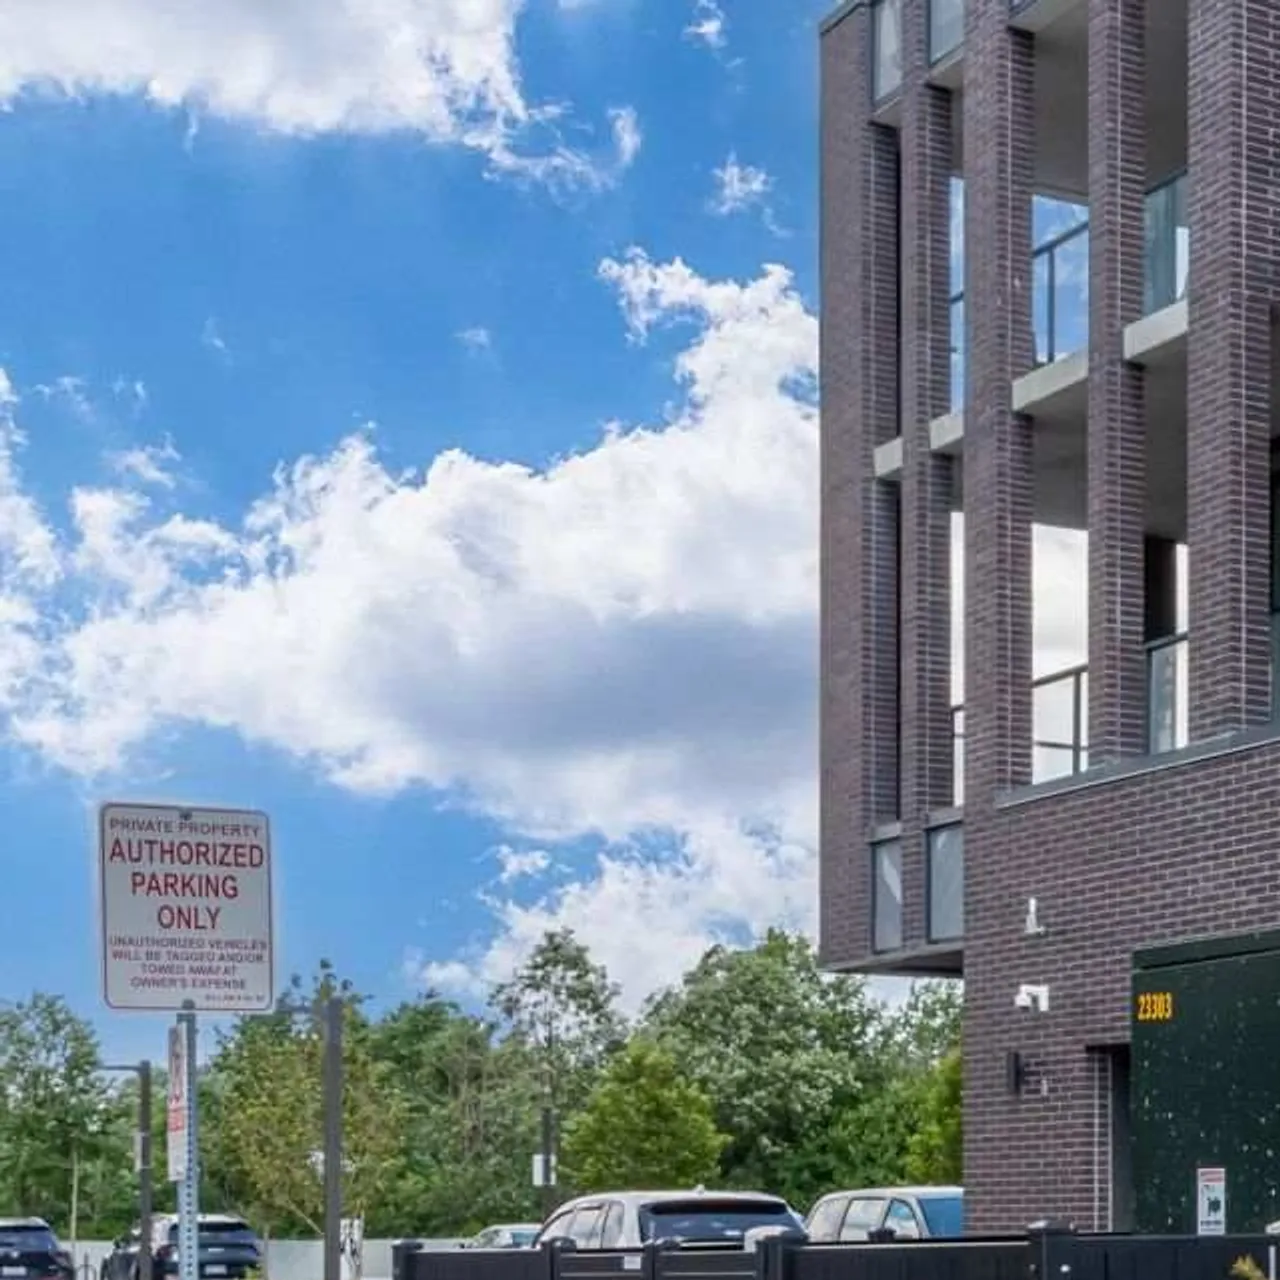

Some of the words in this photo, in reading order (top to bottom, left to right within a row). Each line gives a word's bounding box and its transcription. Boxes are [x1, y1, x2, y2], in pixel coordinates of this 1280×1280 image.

[109, 816, 173, 833] PRIVATE
[178, 820, 260, 837] PROPERTY
[109, 838, 264, 868] AUTHORIZED
[131, 872, 238, 899] PARKING
[157, 904, 221, 930] ONLY
[109, 935, 205, 949] UNAUTHORIZED
[1138, 992, 1172, 1020] 23303
